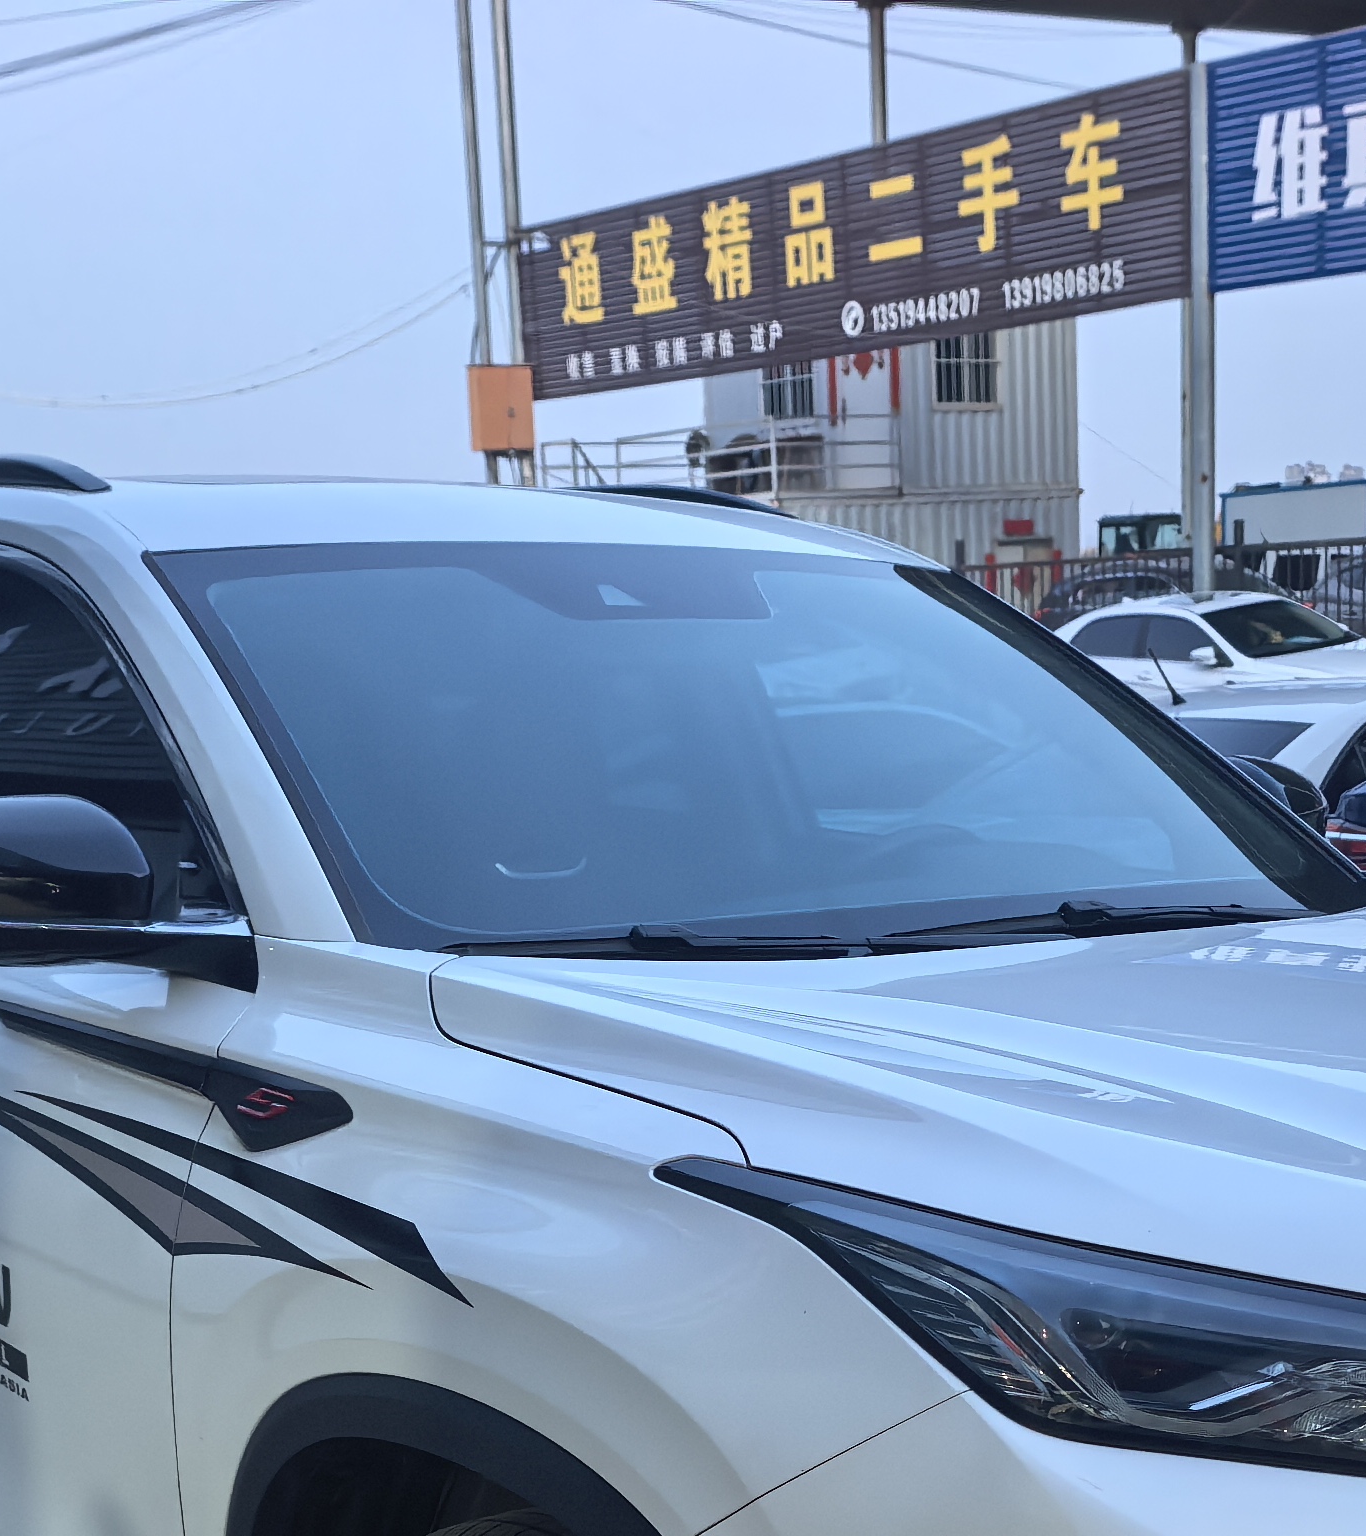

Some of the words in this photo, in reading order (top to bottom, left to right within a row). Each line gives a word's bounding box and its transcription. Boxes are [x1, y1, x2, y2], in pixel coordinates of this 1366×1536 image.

[558, 112, 1124, 325] 通盛精品二手车
[871, 287, 980, 333] 13519448207
[1002, 259, 1125, 310] 13919806825
[0, 1373, 30, 1402] ASIA
